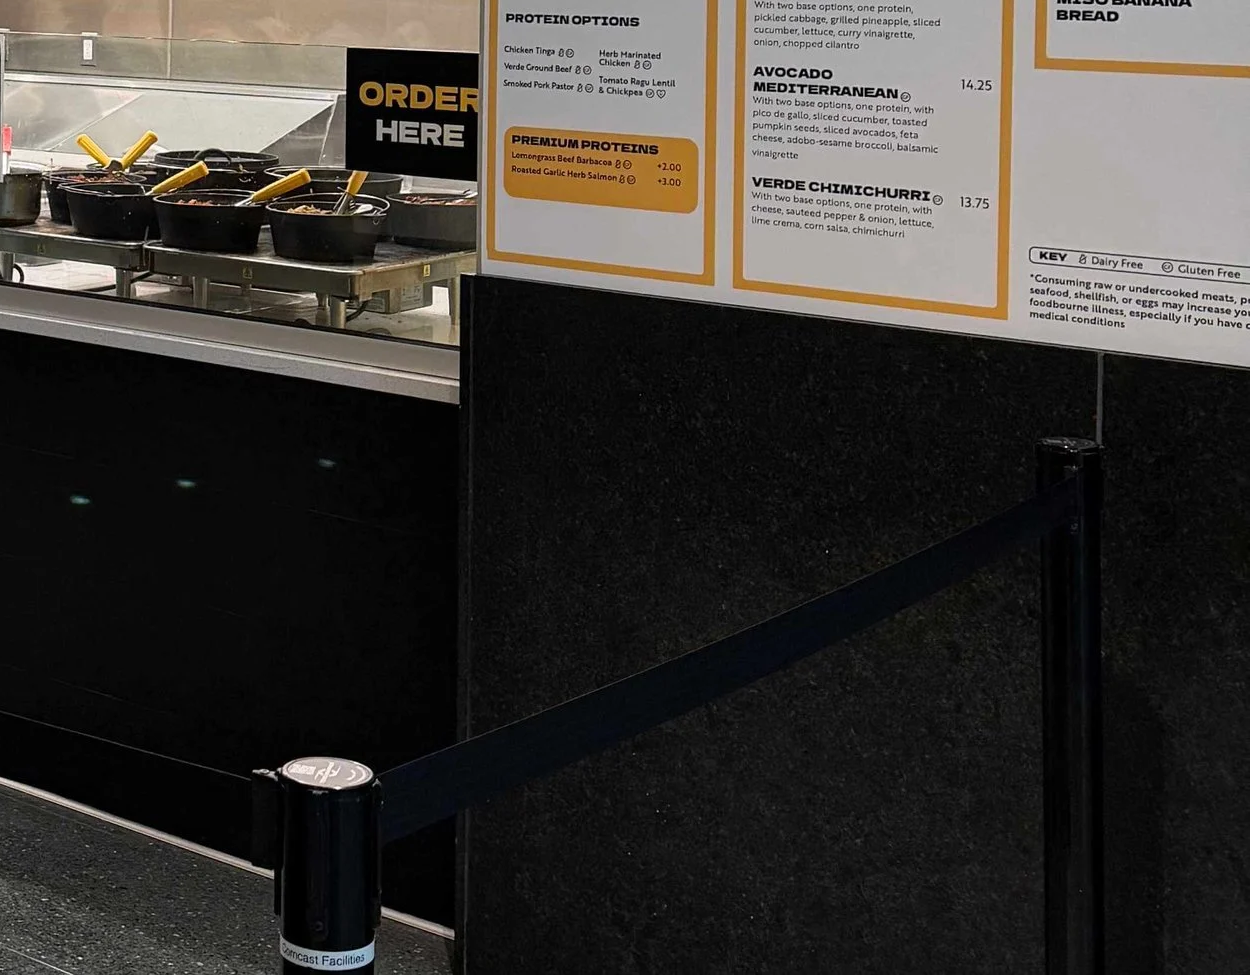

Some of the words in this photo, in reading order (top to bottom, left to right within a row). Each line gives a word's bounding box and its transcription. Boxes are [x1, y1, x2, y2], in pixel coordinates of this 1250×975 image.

[506, 13, 569, 24] PROTEIN
[572, 15, 640, 27] OPTIONS
[1056, 10, 1119, 22] BREAD
[753, 66, 833, 80] AVOCADO
[753, 81, 898, 100] MEDITERRANEAN
[961, 79, 992, 91] 14.25
[359, 81, 478, 112] ORDER
[376, 119, 465, 147] HERE
[512, 135, 579, 149] PREMIUM
[581, 140, 659, 155] PROTEINS
[752, 177, 806, 191] VERDE
[808, 182, 930, 204] CHIMICHURRI
[960, 196, 989, 209] 13.75
[1039, 251, 1068, 262] KEY
[1092, 256, 1119, 269] Dairy
[1121, 258, 1143, 269] Free
[1178, 264, 1214, 276] Gluten
[1217, 268, 1241, 279] Free
[1094, 282, 1113, 290] raw
[1129, 285, 1198, 299] undercooked
[1202, 293, 1237, 304] meats,
[1030, 311, 1069, 322] medical
[1071, 314, 1126, 328] conditions
[322, 954, 364, 966] Facilities
